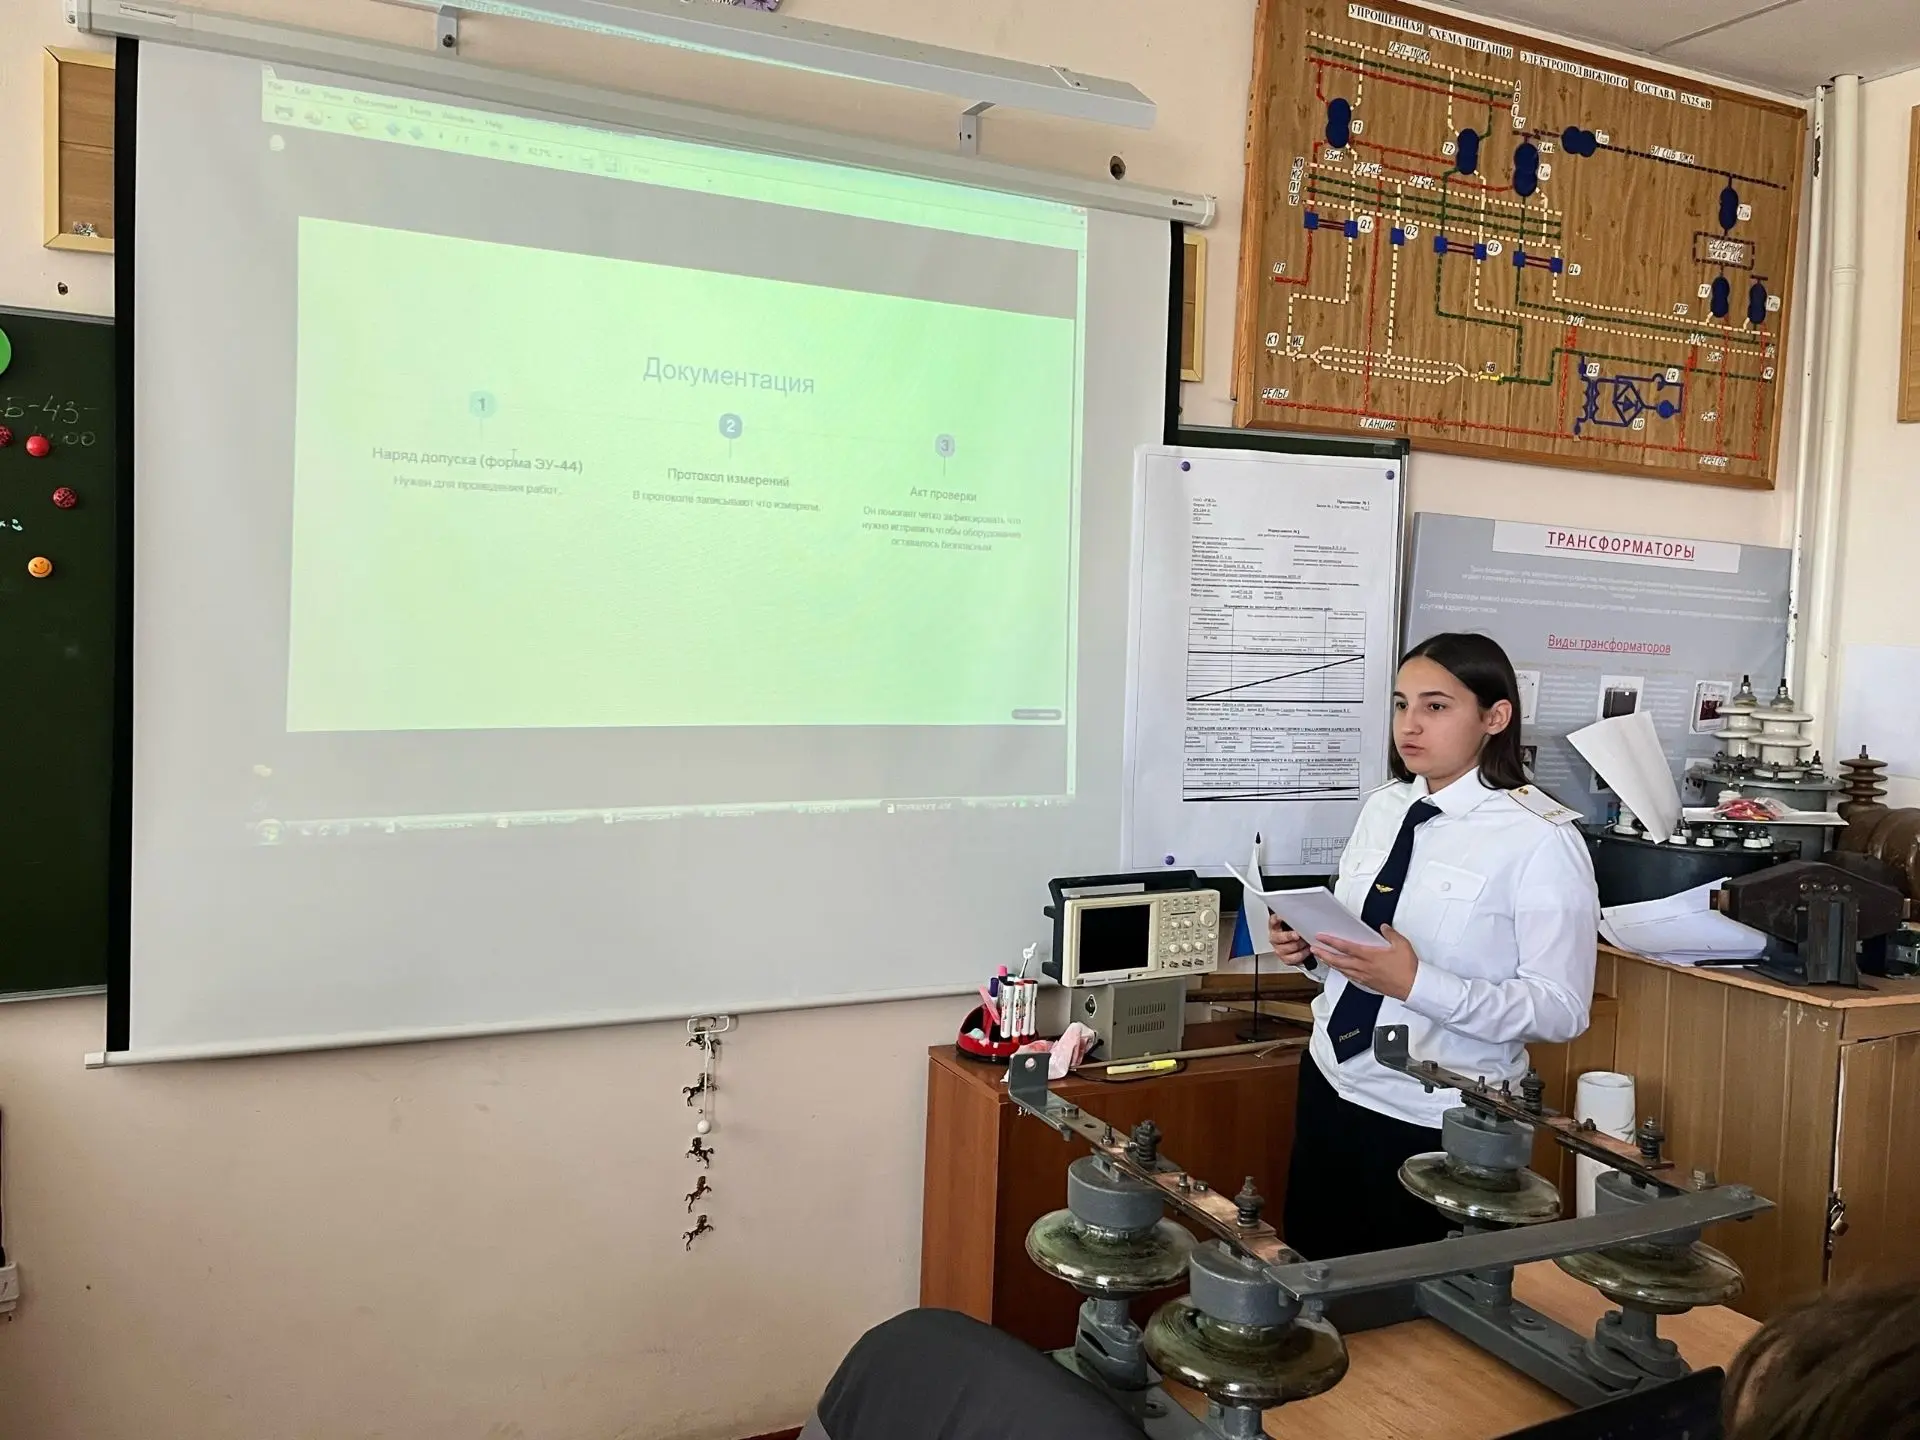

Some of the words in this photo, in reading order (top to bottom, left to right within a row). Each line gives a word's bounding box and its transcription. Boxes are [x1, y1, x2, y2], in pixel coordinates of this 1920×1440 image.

[1429, 27, 1464, 46] СХЕМА
[1465, 36, 1513, 58] ПИТАНИЯ
[1521, 51, 1629, 88] ЭЛЕКТРОПОДВИЖНОГО
[1634, 80, 1676, 100] СОСТАВА
[1360, 219, 1372, 229] Q1
[1405, 226, 1417, 236] Q2
[1487, 243, 1500, 252] Q3
[643, 356, 815, 398] Документация
[372, 446, 418, 464] Наряд
[420, 451, 477, 467] допуска
[480, 453, 532, 471] (форма
[533, 457, 584, 475] ЭУ-44)
[667, 467, 725, 483] Протокол
[726, 472, 790, 488] измерений
[910, 486, 928, 498] Акт
[929, 489, 978, 503] проверки
[862, 505, 877, 517] Он
[1547, 531, 1695, 559] ТРАНСФОРМАТОРЫ
[1548, 634, 1578, 651] Виды
[1580, 636, 1672, 655] трансформаторов
